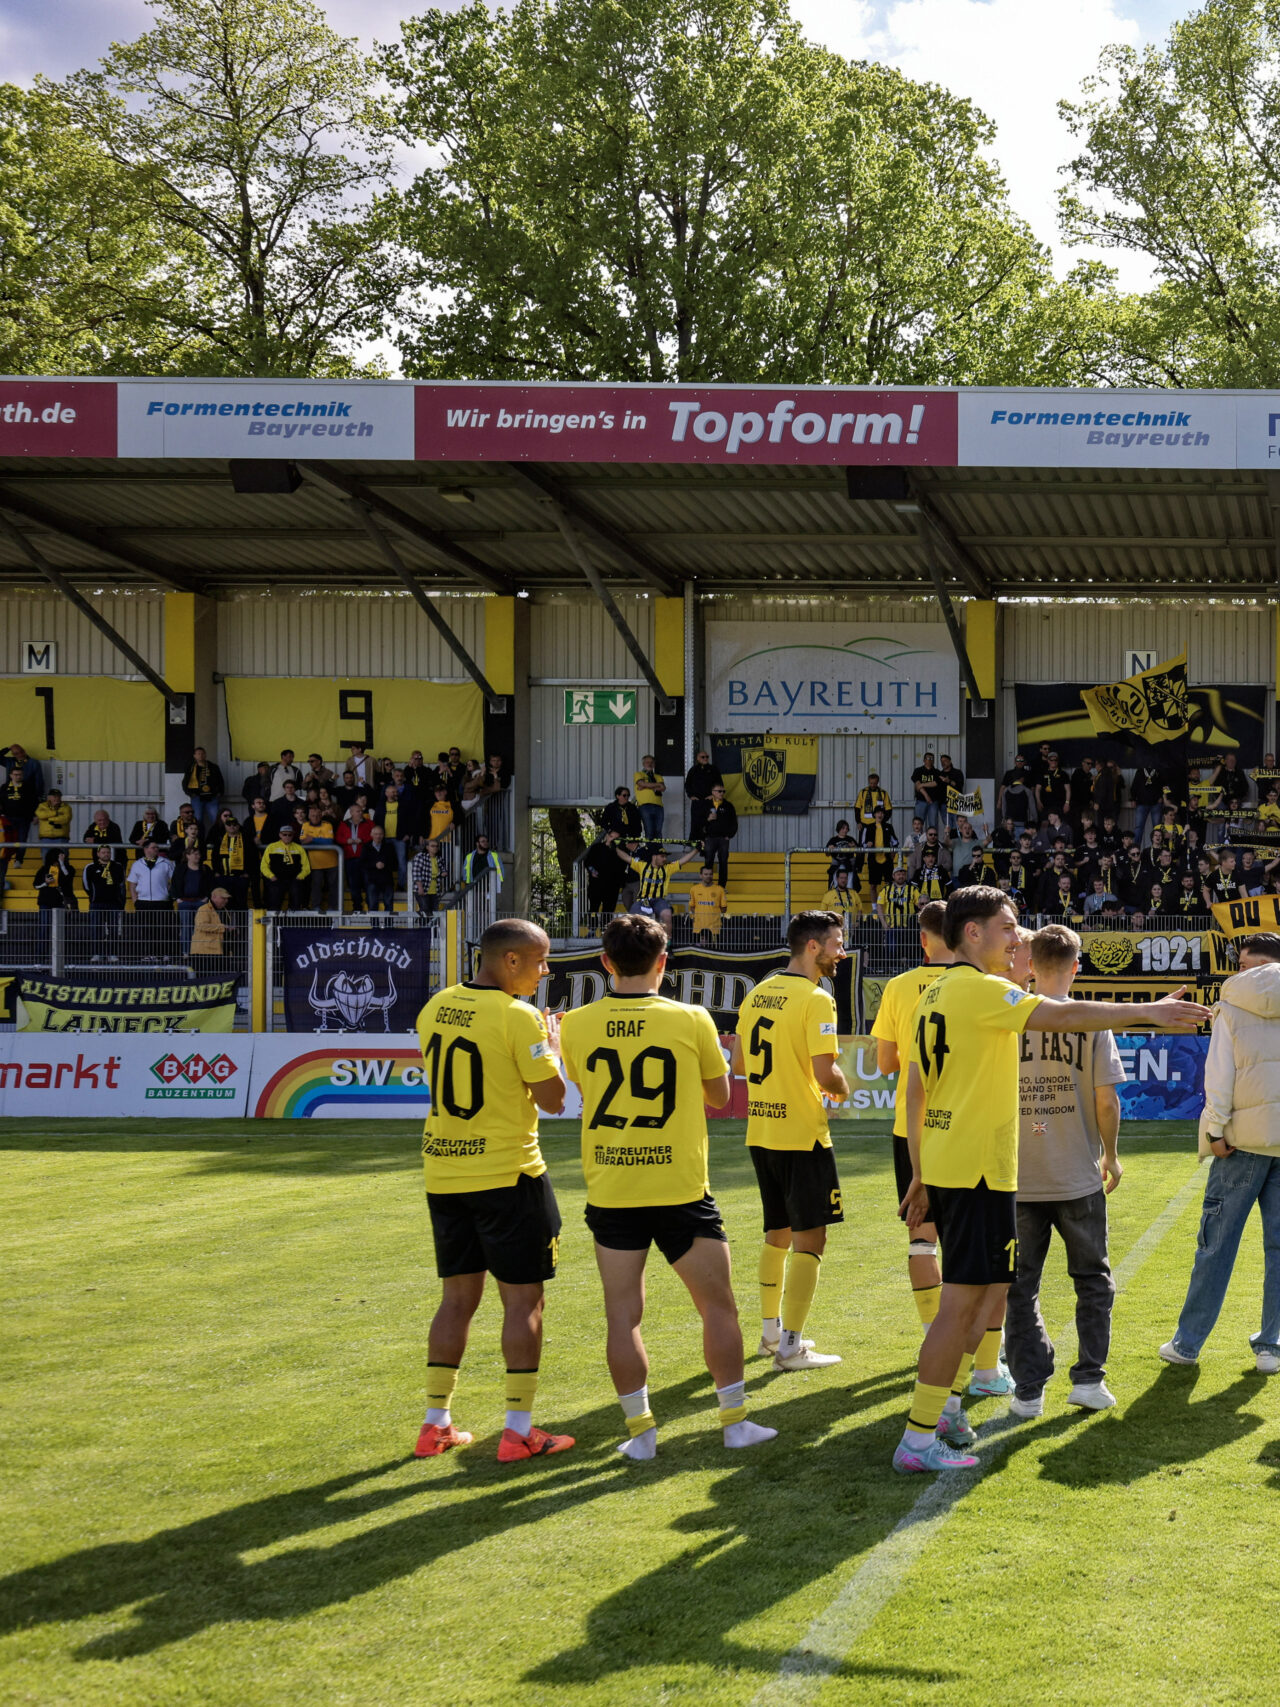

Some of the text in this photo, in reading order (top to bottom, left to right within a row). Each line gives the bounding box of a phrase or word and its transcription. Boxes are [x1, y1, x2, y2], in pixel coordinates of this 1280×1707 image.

[0, 401, 77, 423] th.de
[147, 401, 352, 417] Formentechnik
[990, 411, 1191, 427] Formentechnik
[248, 421, 374, 438] Bayreuth
[446, 409, 490, 428] Wir
[623, 410, 647, 429] in
[668, 401, 925, 453] Topform!
[1086, 430, 1210, 448] Bayreuth
[27, 644, 51, 669] M
[1132, 653, 1151, 676] N
[728, 680, 938, 716] BAYREUTH
[35, 687, 55, 750] 1
[340, 690, 374, 750] 9
[716, 736, 816, 747] ALTSTADT KULT
[1229, 901, 1261, 928] DU
[1098, 950, 1128, 965] 1921
[1136, 935, 1202, 972] 1921
[21, 980, 236, 1005] ALTSTADTFREUNDE
[752, 994, 788, 1010] SCHWARZ
[435, 1006, 476, 1028] GEORGE
[607, 1020, 646, 1037] GRAF
[749, 1016, 775, 1085] 5
[163, 1060, 230, 1077] BHG
[330, 1059, 395, 1087] SW
[425, 1032, 484, 1120] 10
[1035, 1075, 1070, 1084] LONDON
[148, 1089, 233, 1097] BAUZENTRUM
[586, 1045, 677, 1130] 29
[1047, 1084, 1077, 1092] STREET
[1034, 1105, 1075, 1115] KINGDOM
[604, 1155, 673, 1166] BRAUHAUS
[606, 1146, 672, 1156] BAYREUTHER
[830, 1189, 843, 1215] 5
